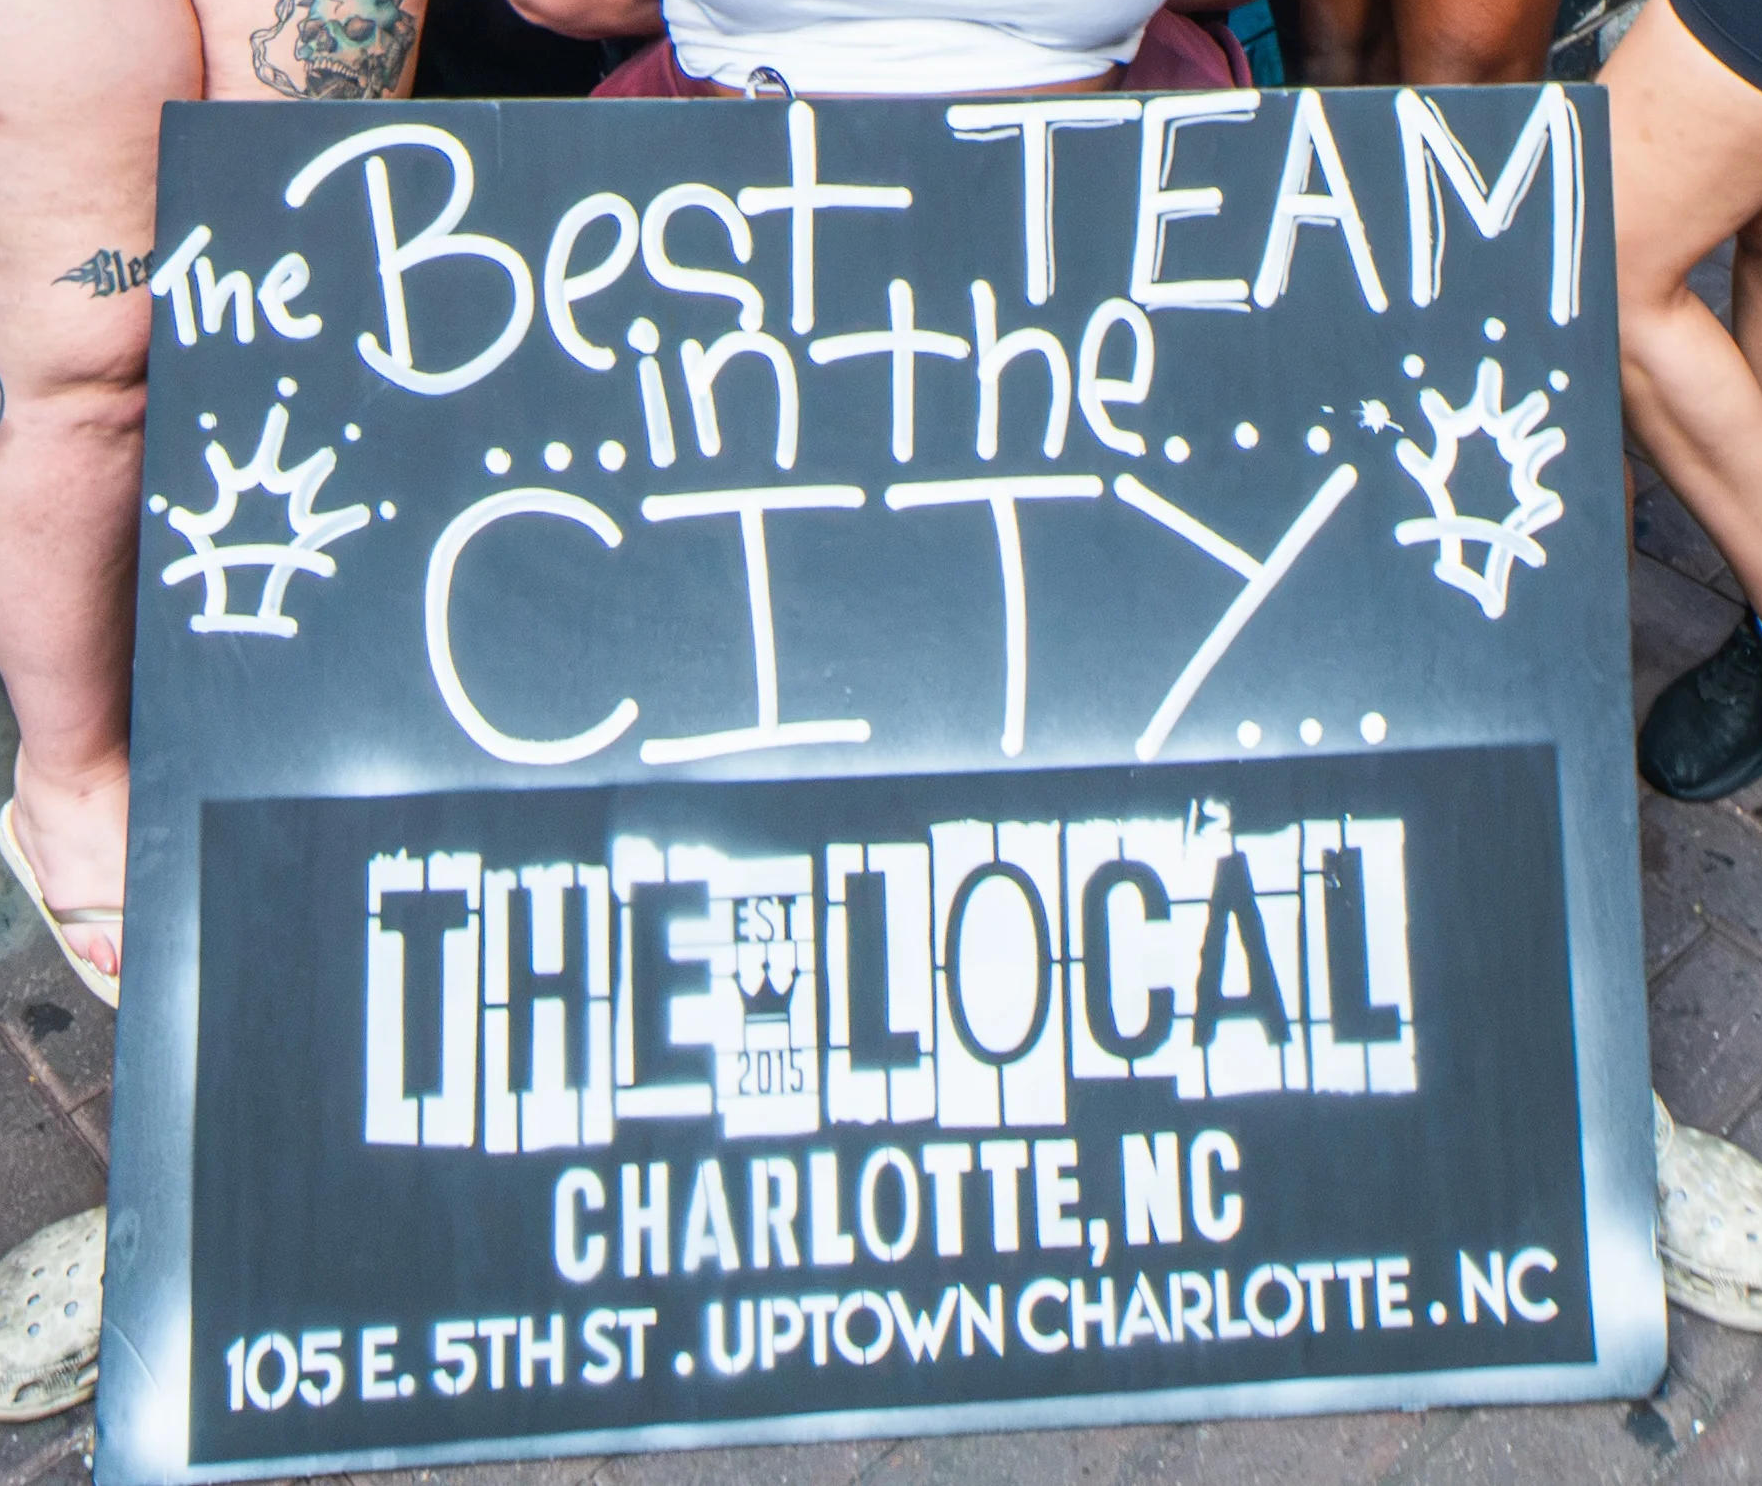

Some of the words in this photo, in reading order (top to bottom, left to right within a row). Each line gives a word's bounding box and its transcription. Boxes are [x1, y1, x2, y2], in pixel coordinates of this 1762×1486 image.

[151, 225, 323, 347] The
[286, 100, 912, 395] Best
[948, 84, 1583, 324] TEAM
[377, 876, 715, 1104] THE
[842, 842, 1405, 1075] LOCAL
[733, 895, 796, 942] EST
[737, 1048, 806, 1097] 2015
[226, 1328, 344, 1412] 105
[359, 1326, 416, 1400] E.
[432, 1313, 564, 1396] 5TH
[707, 1282, 1005, 1374] UPTOWN
[1016, 1256, 1414, 1355] CHARLOTTE
[1459, 1247, 1560, 1327] NC
